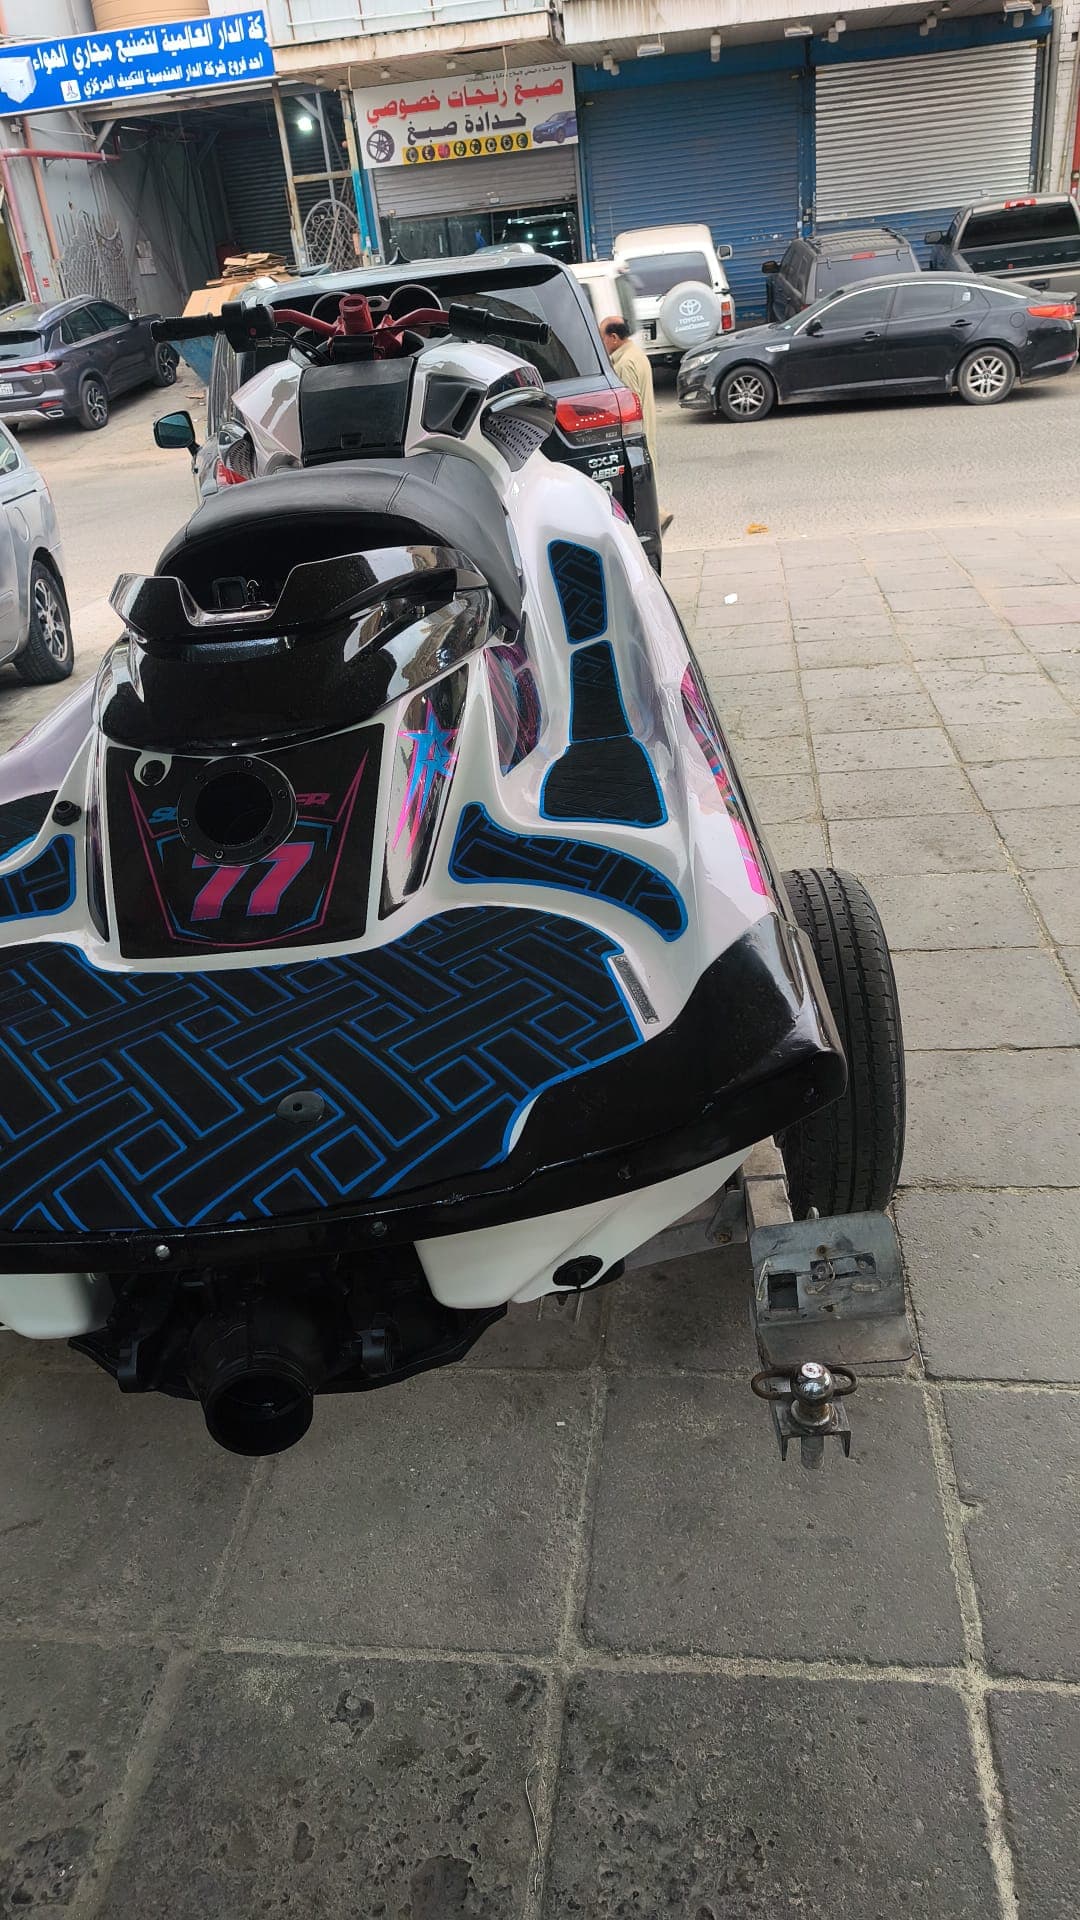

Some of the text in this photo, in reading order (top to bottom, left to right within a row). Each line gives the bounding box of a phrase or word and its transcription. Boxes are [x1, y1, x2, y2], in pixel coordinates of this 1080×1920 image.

[115, 29, 159, 63] لتصنيع
[161, 22, 213, 56] العالمية
[217, 17, 245, 50] الدار
[32, 43, 69, 75] الهواء
[72, 39, 113, 75] مجاري
[185, 62, 203, 82] الدار
[204, 59, 227, 78] شركة
[227, 56, 247, 76] فروع
[83, 75, 116, 99] المركزي
[146, 64, 183, 87] الهندسية
[366, 77, 564, 128] صبغ رنجات خصوصي
[407, 111, 527, 146] حدادة صبغ
[679, 315, 705, 325] TOYOTA
[190, 841, 315, 922] 77
